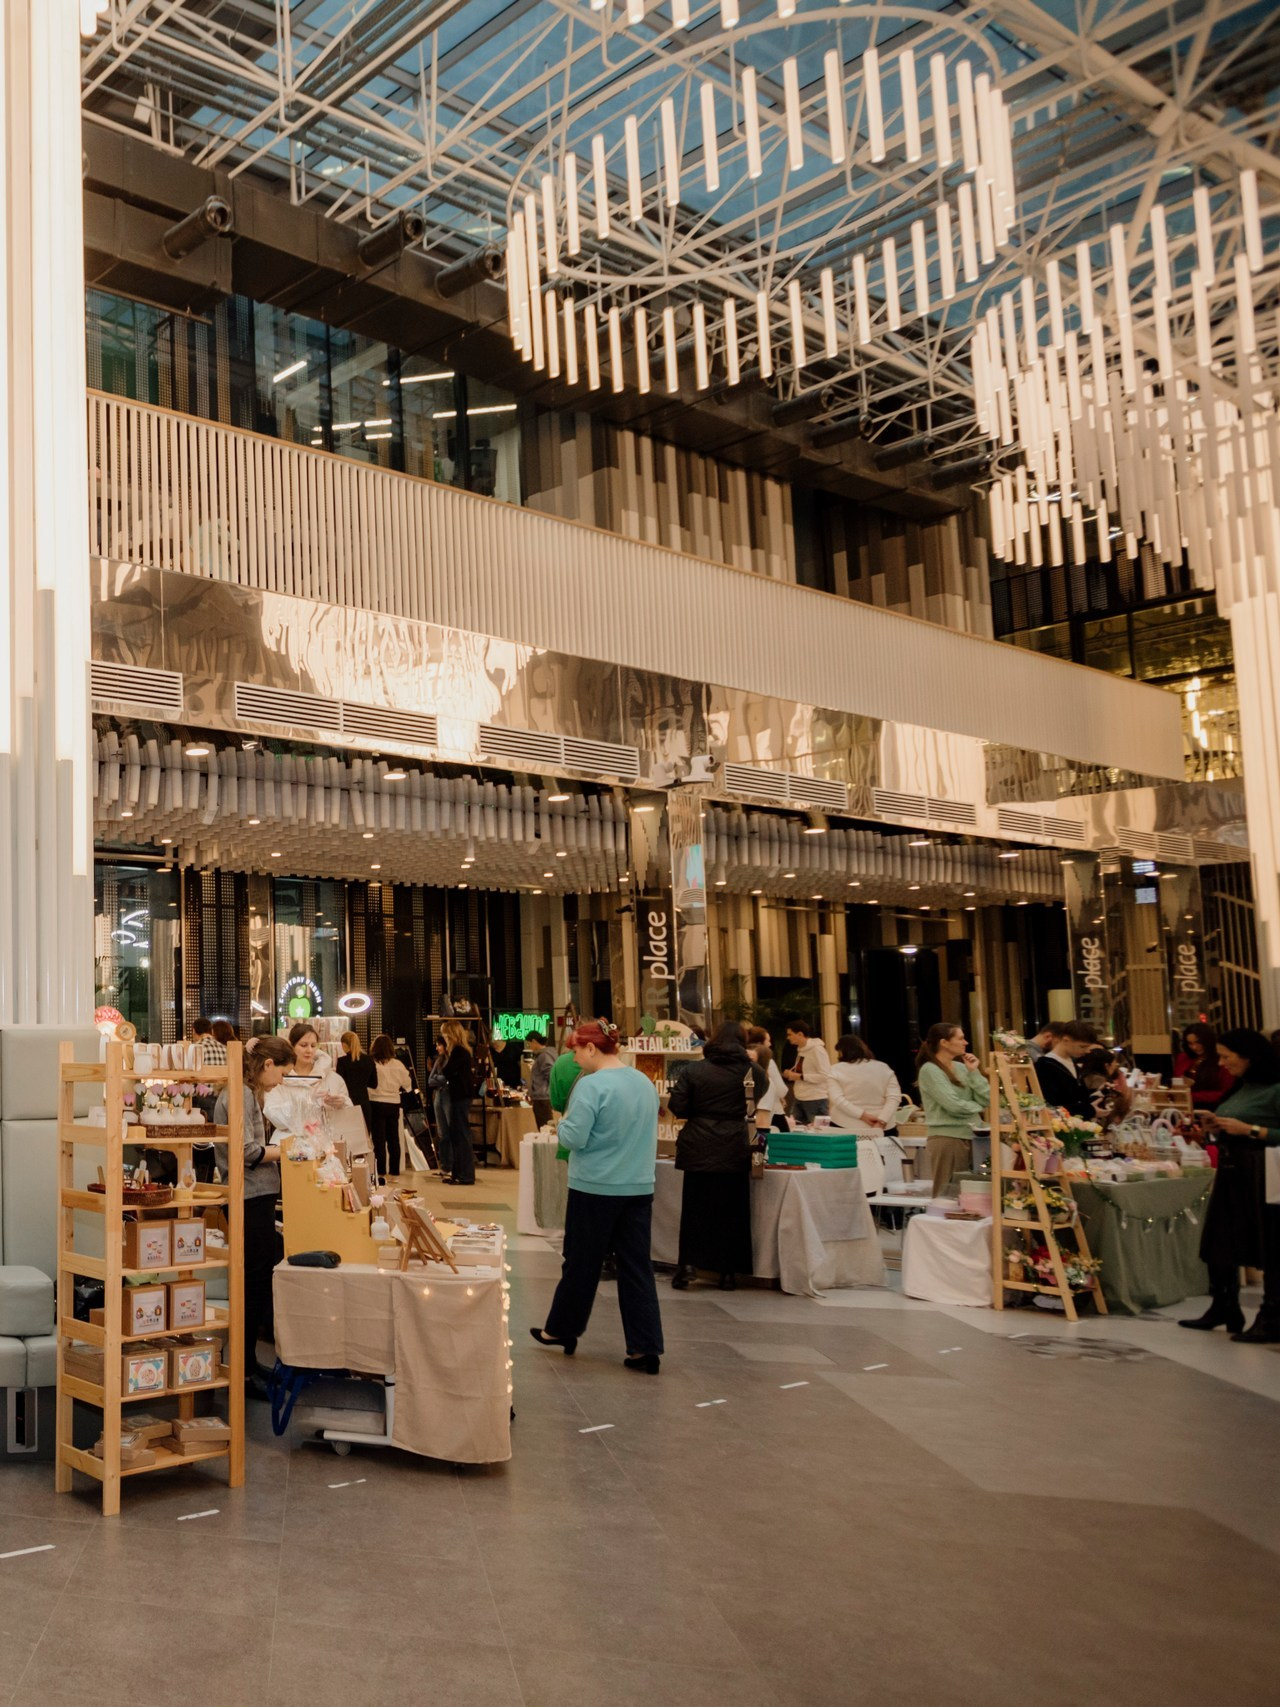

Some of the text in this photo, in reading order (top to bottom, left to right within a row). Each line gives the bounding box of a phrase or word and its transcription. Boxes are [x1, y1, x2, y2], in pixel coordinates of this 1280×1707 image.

[643, 911, 675, 980] place
[1077, 937, 1108, 988] place
[1173, 944, 1205, 992] place
[628, 1037, 691, 1051] DETAIL PRO
